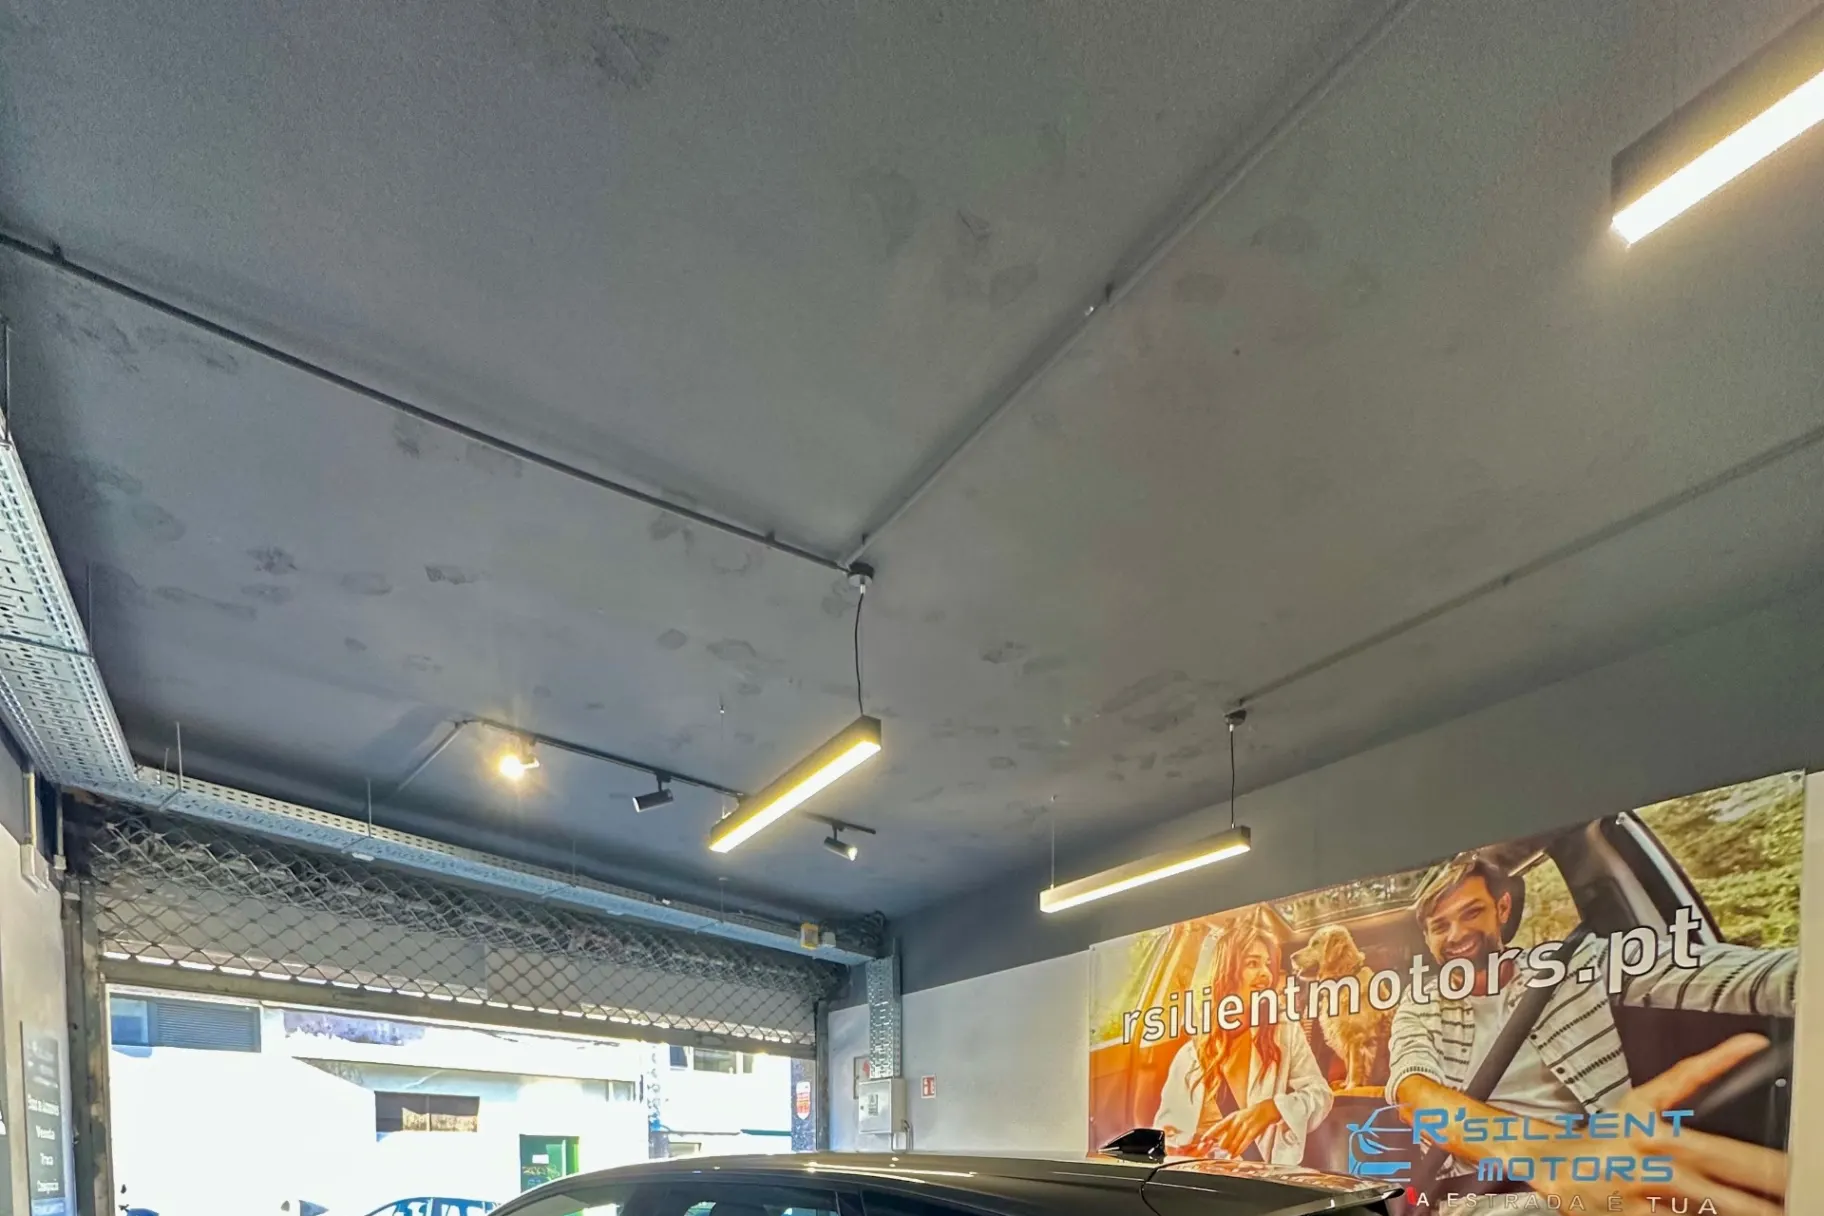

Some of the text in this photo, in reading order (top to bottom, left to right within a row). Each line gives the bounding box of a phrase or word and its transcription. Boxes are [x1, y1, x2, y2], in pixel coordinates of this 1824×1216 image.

[1121, 904, 1703, 1044] rsilientmotors.pt
[1476, 1156, 1675, 1183] MOTORS
[1415, 1190, 1719, 1216] A ESTRADA É TUA
